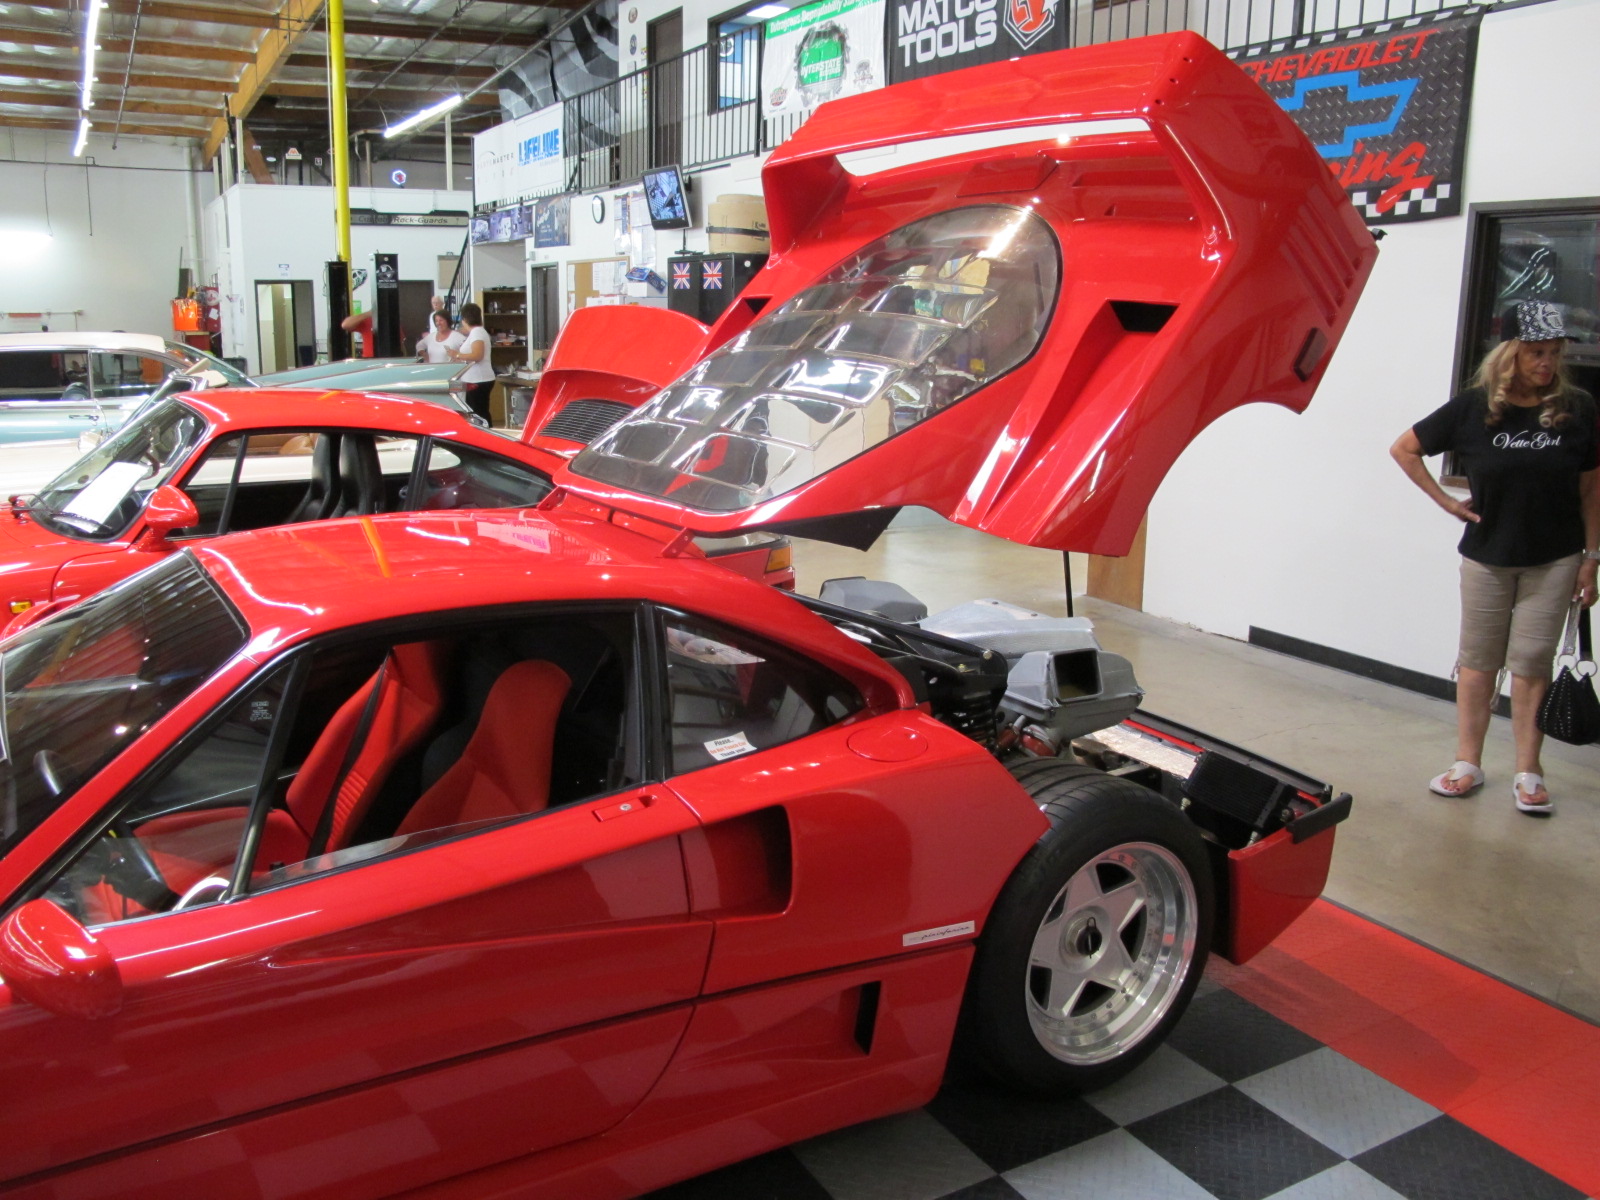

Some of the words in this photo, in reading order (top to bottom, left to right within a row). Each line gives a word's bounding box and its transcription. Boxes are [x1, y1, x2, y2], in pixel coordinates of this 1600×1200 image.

[898, 10, 998, 68] TOOLS
[1239, 28, 1441, 83] CHEVROLET
[393, 216, 448, 224] Rock-Guards
[1492, 430, 1530, 449] Vette
[1530, 432, 1562, 449] Girl
